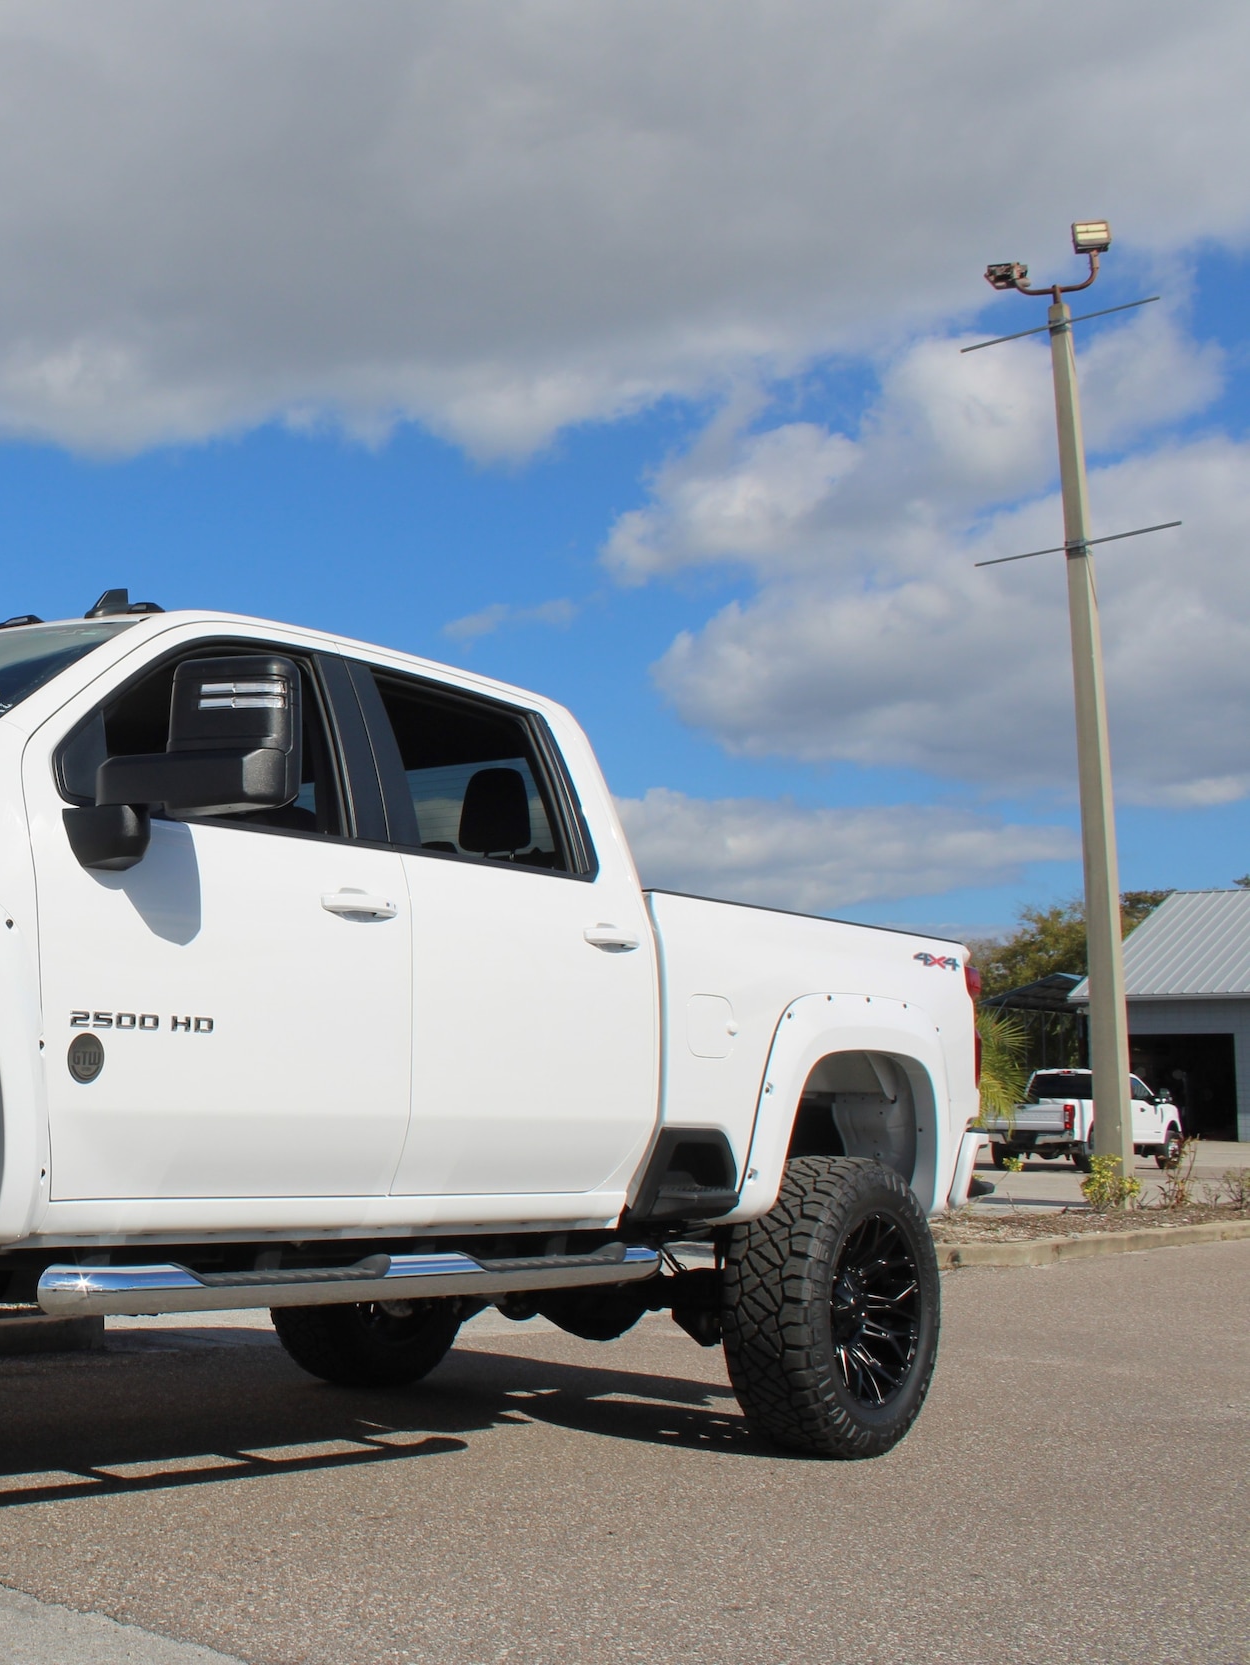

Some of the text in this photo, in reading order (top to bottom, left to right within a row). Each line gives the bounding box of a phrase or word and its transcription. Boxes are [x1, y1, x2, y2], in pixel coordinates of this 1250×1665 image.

[69, 1009, 214, 1034] 2500 HD
[72, 1050, 100, 1066] GTW
